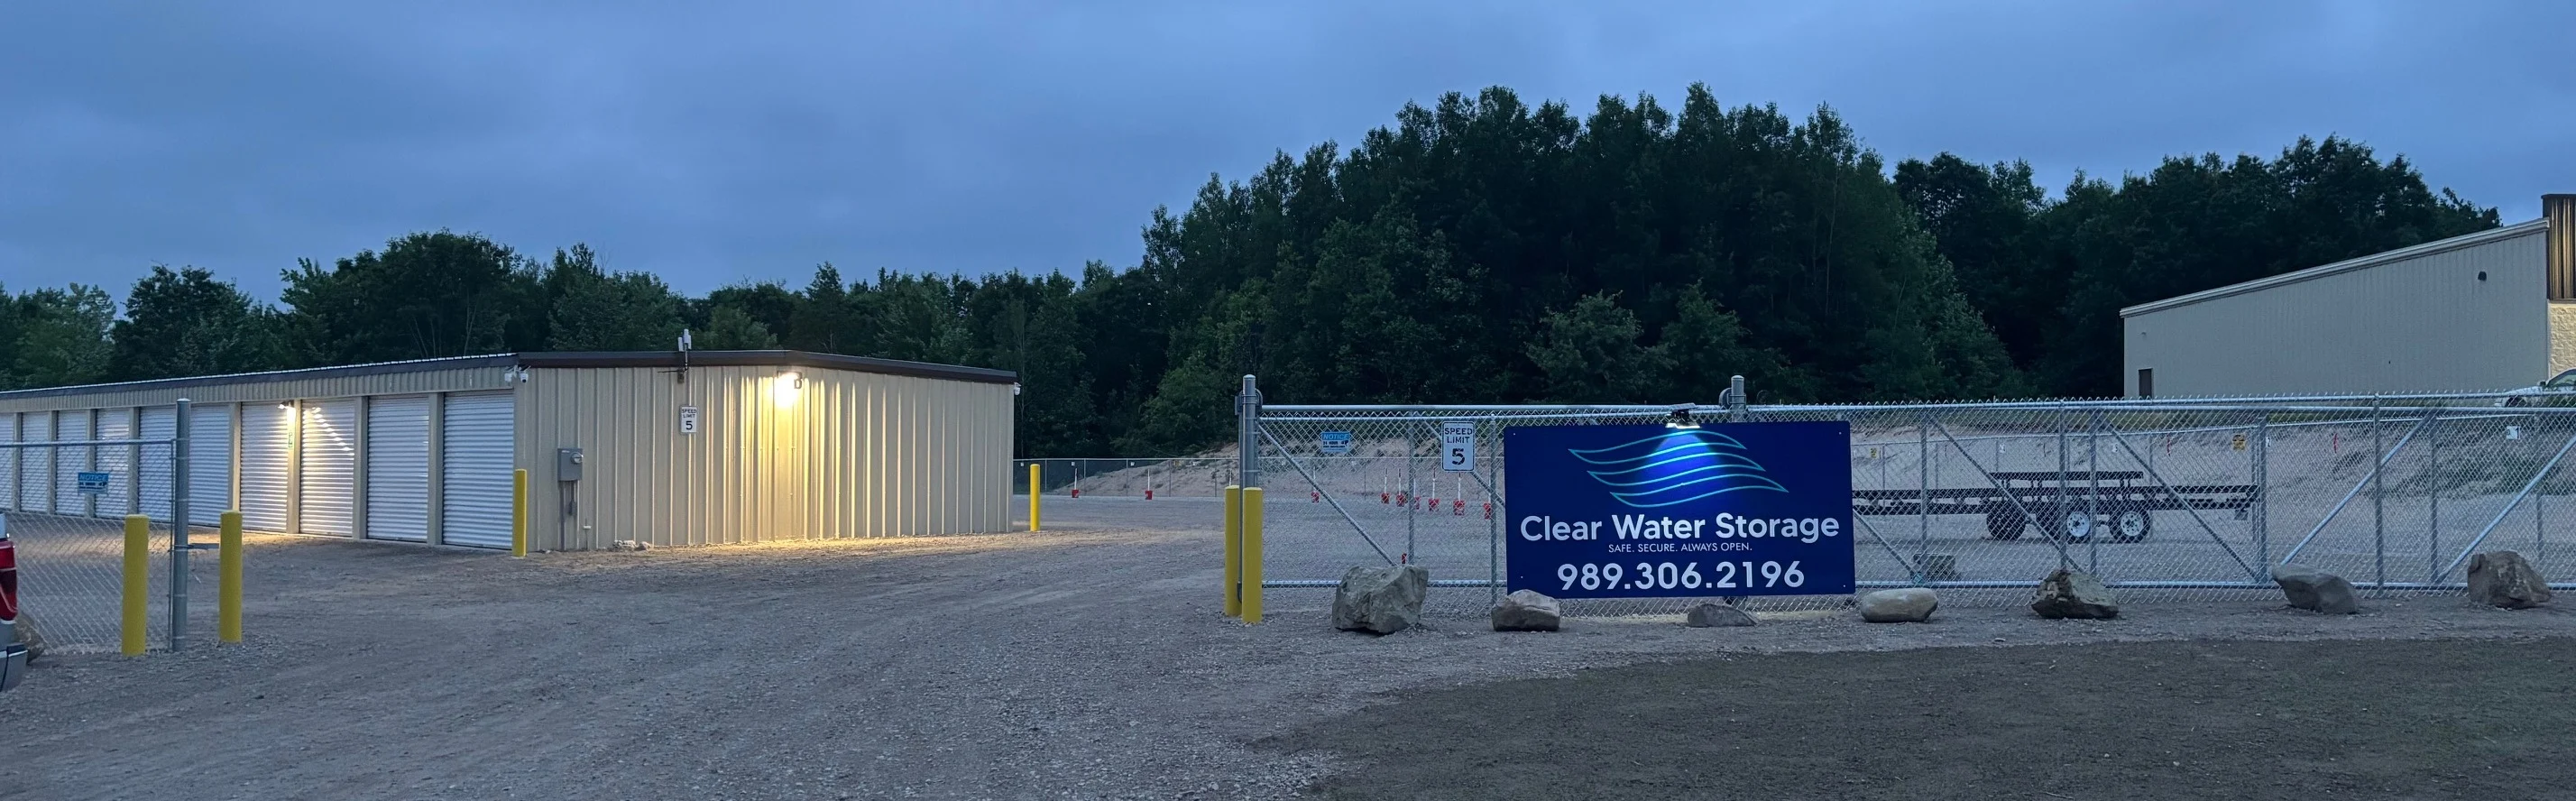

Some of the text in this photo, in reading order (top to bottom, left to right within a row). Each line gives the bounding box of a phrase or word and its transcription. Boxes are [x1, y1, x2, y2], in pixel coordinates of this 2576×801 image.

[685, 420, 693, 430] 5
[1444, 428, 1473, 436] SPEED
[1447, 436, 1470, 444] LIMIT
[1451, 447, 1466, 465] 5
[1520, 512, 1840, 544] Clear Water Storage
[1608, 542, 1753, 553] SAFE. SECURE. ALWAYS OPEN.
[1557, 560, 1805, 591] 989.306.2196
